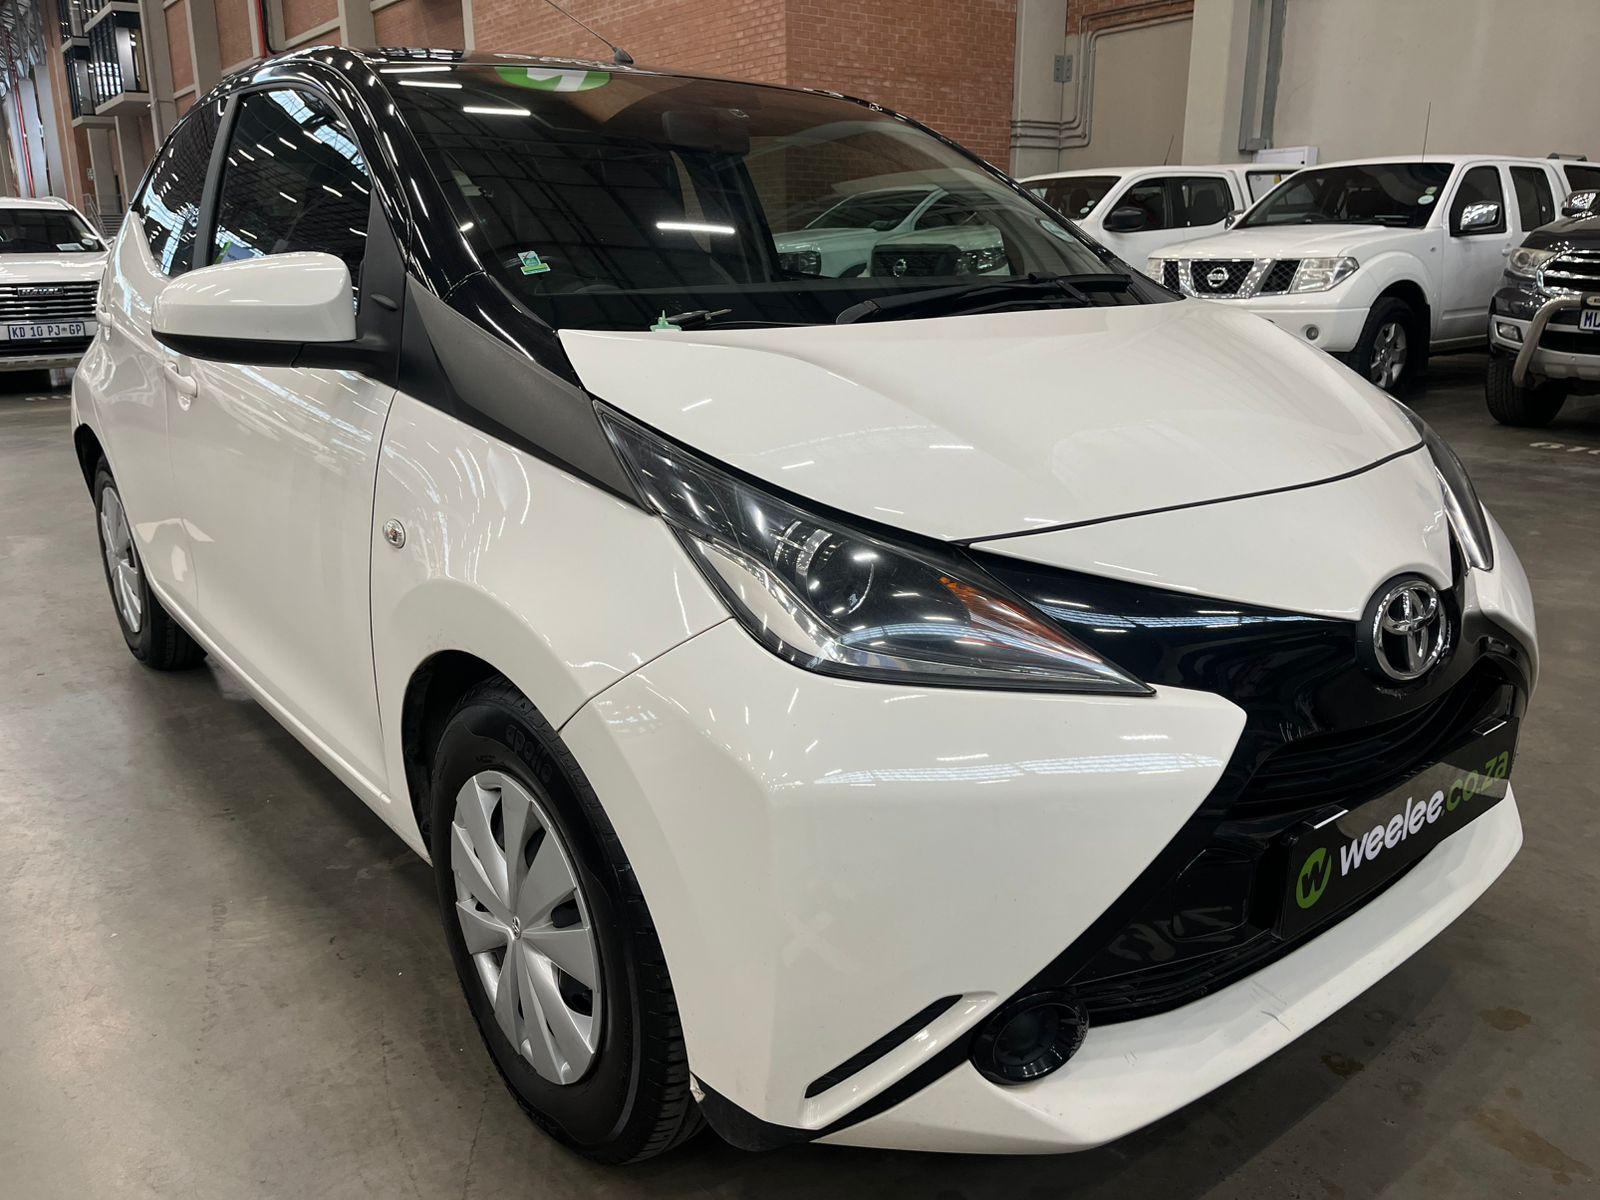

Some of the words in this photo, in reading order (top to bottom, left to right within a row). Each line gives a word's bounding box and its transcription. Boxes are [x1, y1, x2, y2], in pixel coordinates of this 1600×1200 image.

[12, 326, 26, 338] KD
[30, 325, 43, 337] 10
[48, 325, 61, 336] PJ
[69, 324, 82, 335] GP
[505, 724, 553, 784] apollo
